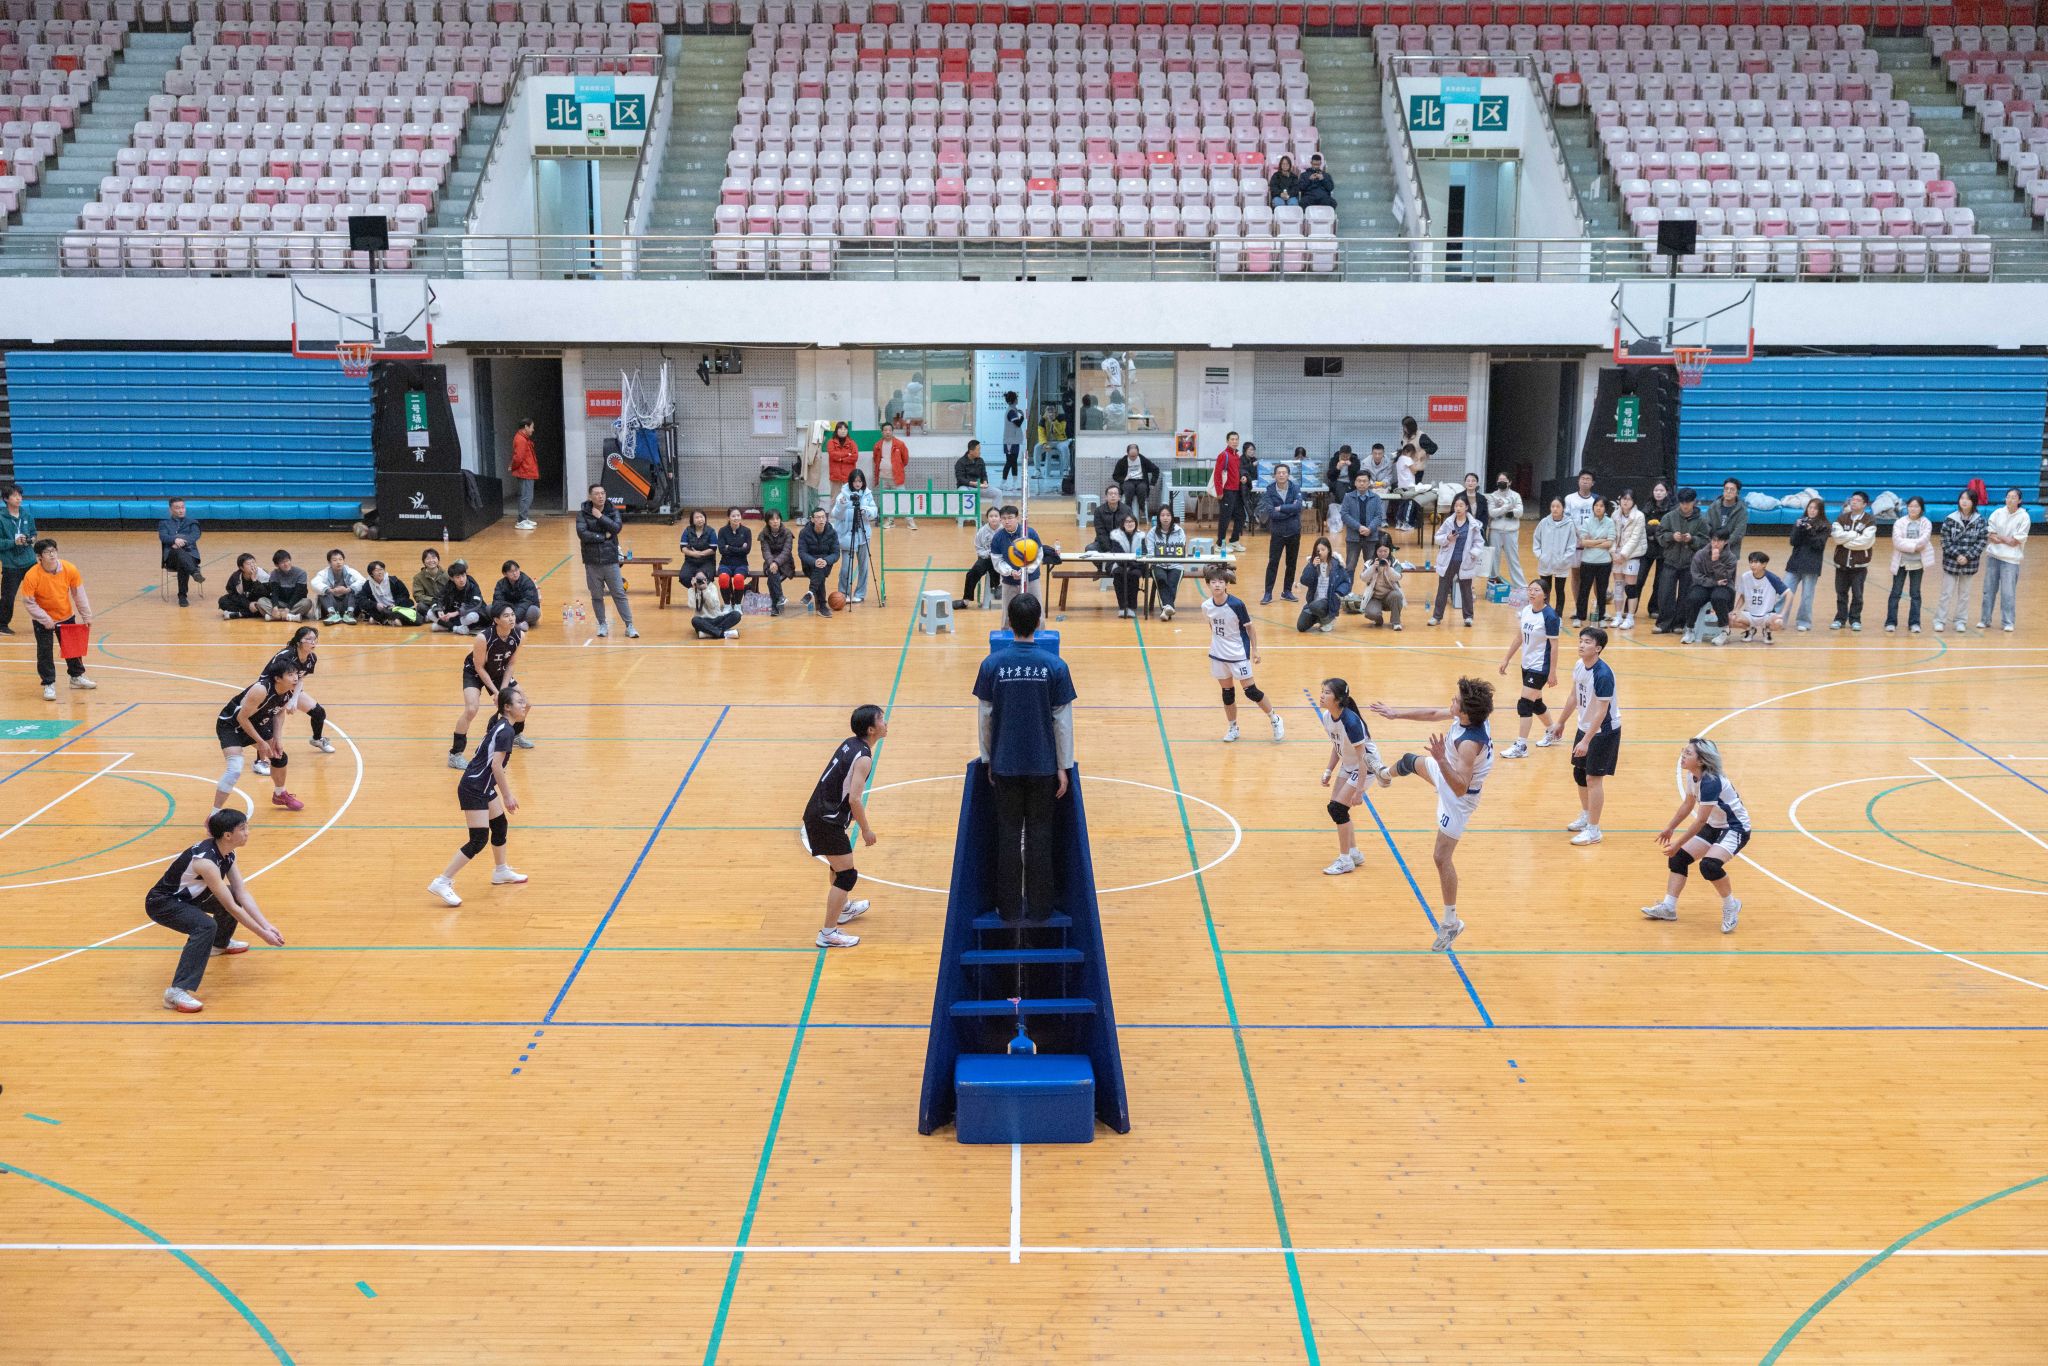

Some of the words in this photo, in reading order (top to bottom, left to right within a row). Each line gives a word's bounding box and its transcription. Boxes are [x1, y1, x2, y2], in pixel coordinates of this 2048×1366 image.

[917, 494, 923, 510] 1
[964, 494, 974, 509] 3
[1176, 546, 1183, 556] 3
[1752, 595, 1763, 606] 25
